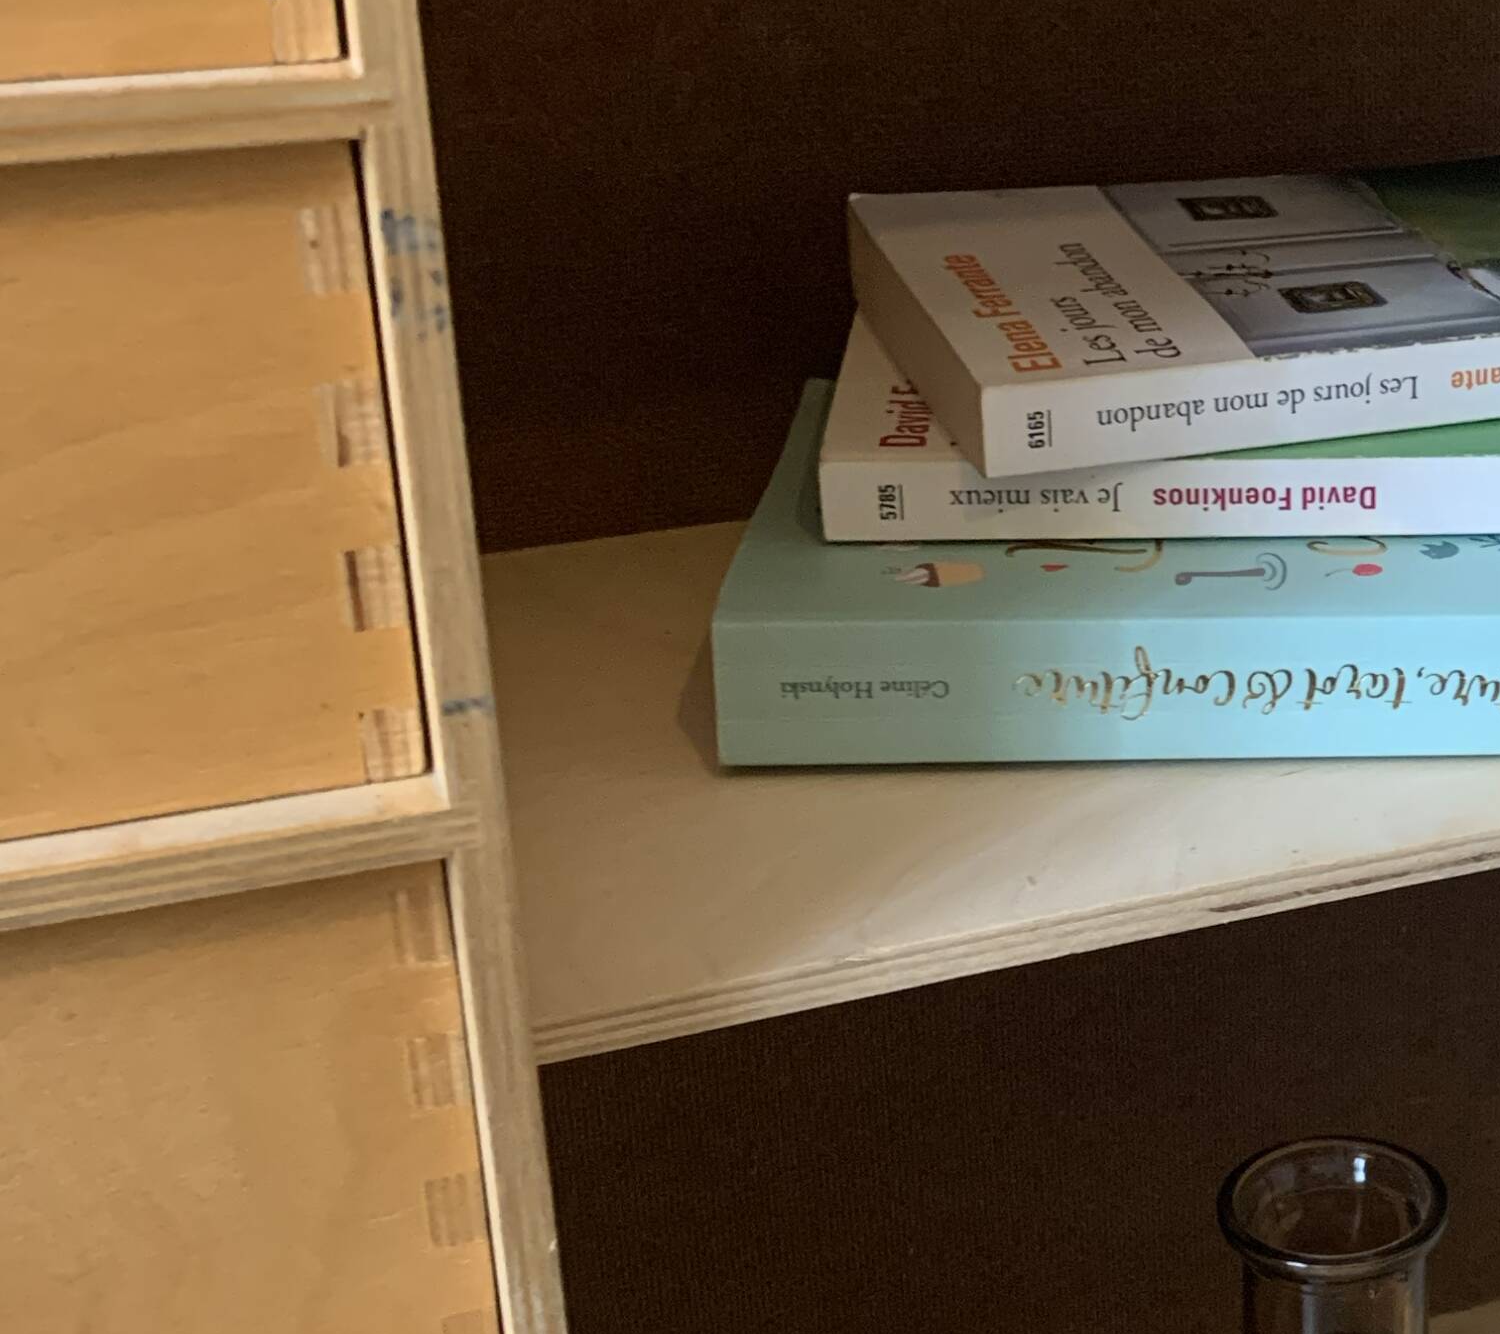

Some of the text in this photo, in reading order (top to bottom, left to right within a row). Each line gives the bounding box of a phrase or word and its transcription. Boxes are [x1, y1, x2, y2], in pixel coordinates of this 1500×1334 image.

[943, 254, 1063, 374] Elena Ferrante
[1055, 242, 1182, 360] de mon abandon
[1050, 295, 1128, 367] Les jours
[1214, 391, 1269, 410] mon
[1276, 389, 1306, 414] de
[1313, 373, 1373, 405] jours
[1379, 375, 1419, 400] Les
[879, 399, 934, 447] David
[1027, 411, 1047, 449] 6165
[1096, 398, 1205, 432] abandon
[878, 484, 897, 521] 5785
[949, 482, 1377, 514] David Foenkinos Je vais mieux
[880, 680, 950, 700] Céline
[1296, 663, 1413, 711] tarot
